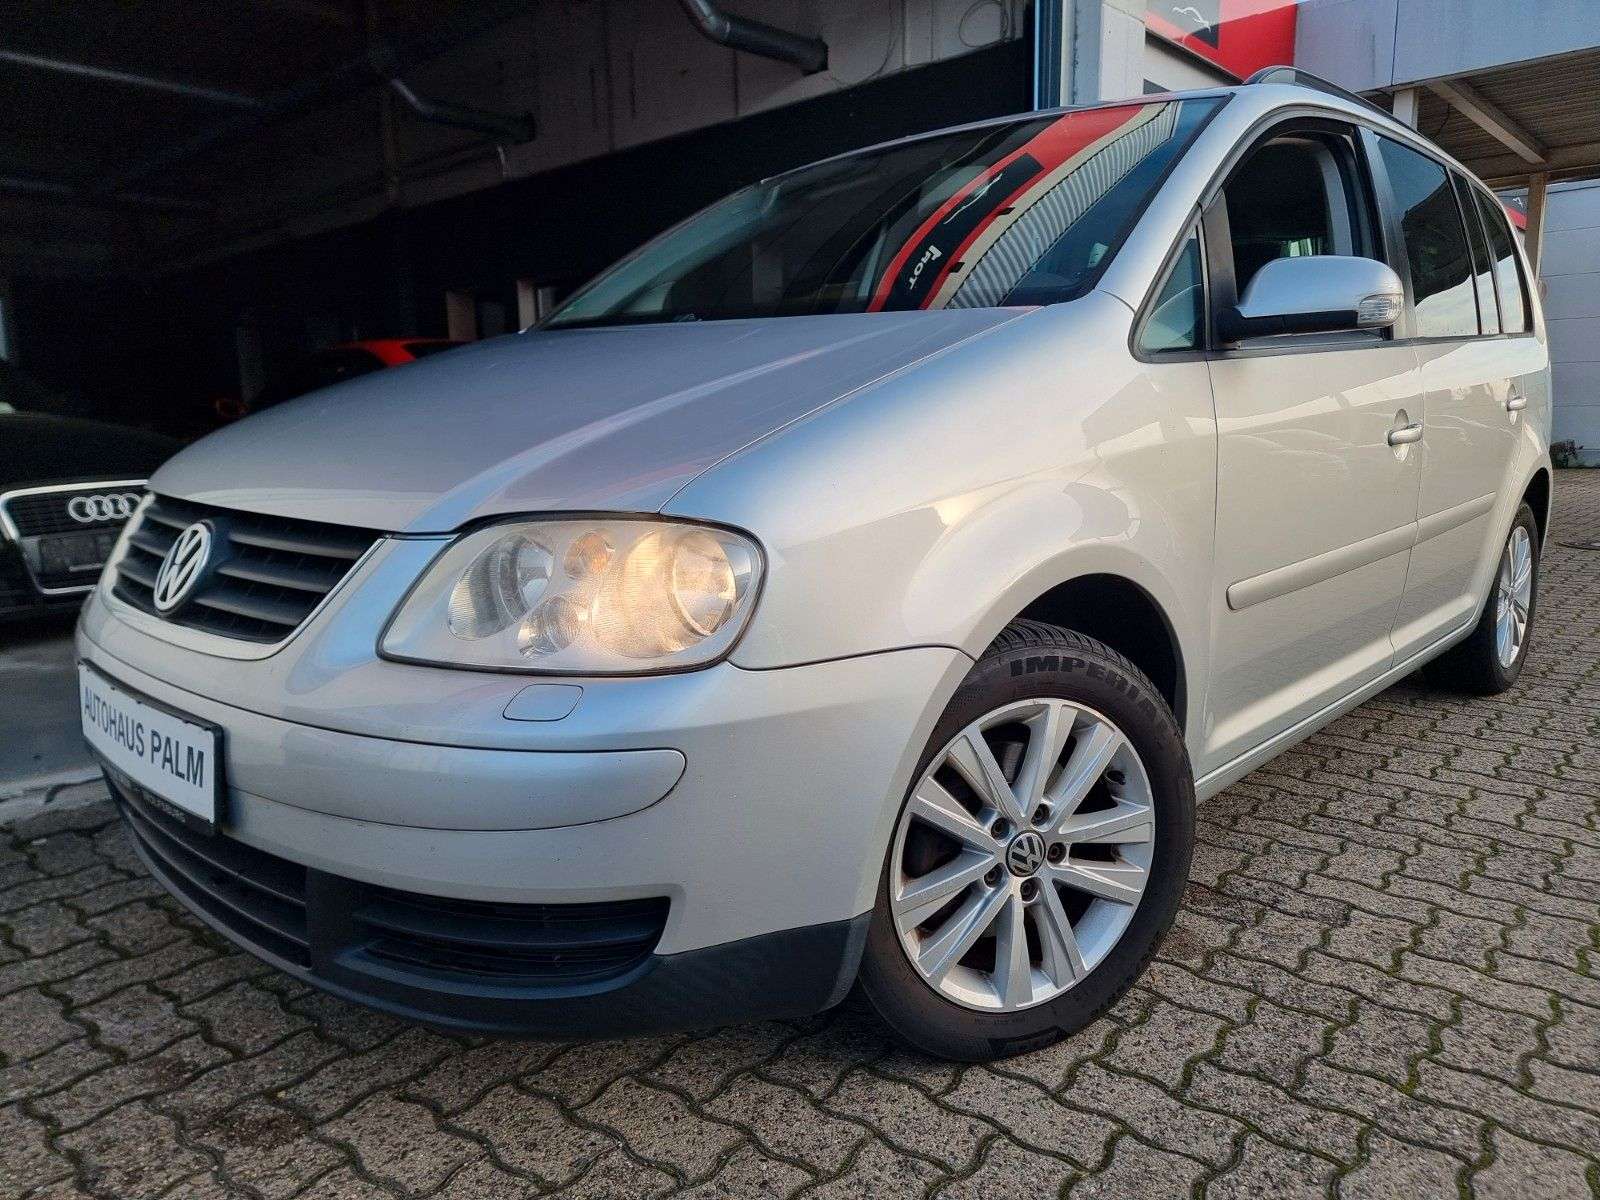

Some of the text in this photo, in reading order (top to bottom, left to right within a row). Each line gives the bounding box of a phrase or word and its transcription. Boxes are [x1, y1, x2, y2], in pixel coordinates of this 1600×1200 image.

[154, 522, 211, 611] VW
[84, 686, 205, 788] AUTOHAUS PALM
[1007, 831, 1046, 876] VW
